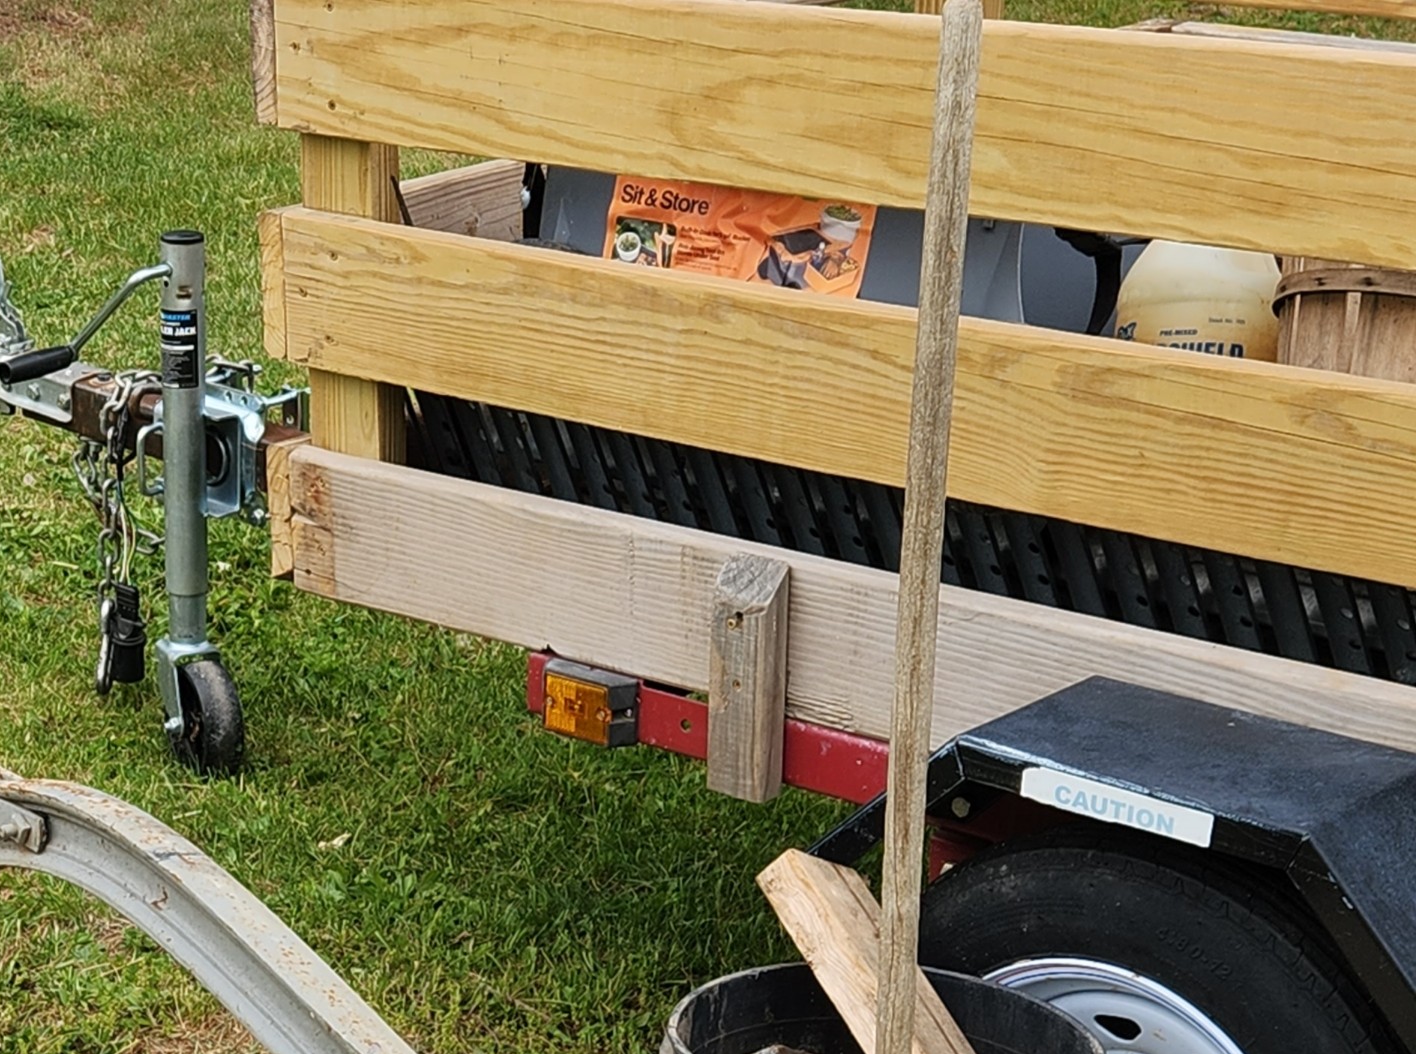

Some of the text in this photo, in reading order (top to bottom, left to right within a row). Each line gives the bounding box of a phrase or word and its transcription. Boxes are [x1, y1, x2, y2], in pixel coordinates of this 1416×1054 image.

[621, 184, 709, 215] Sit & Store
[1054, 785, 1175, 835] CAUTION
